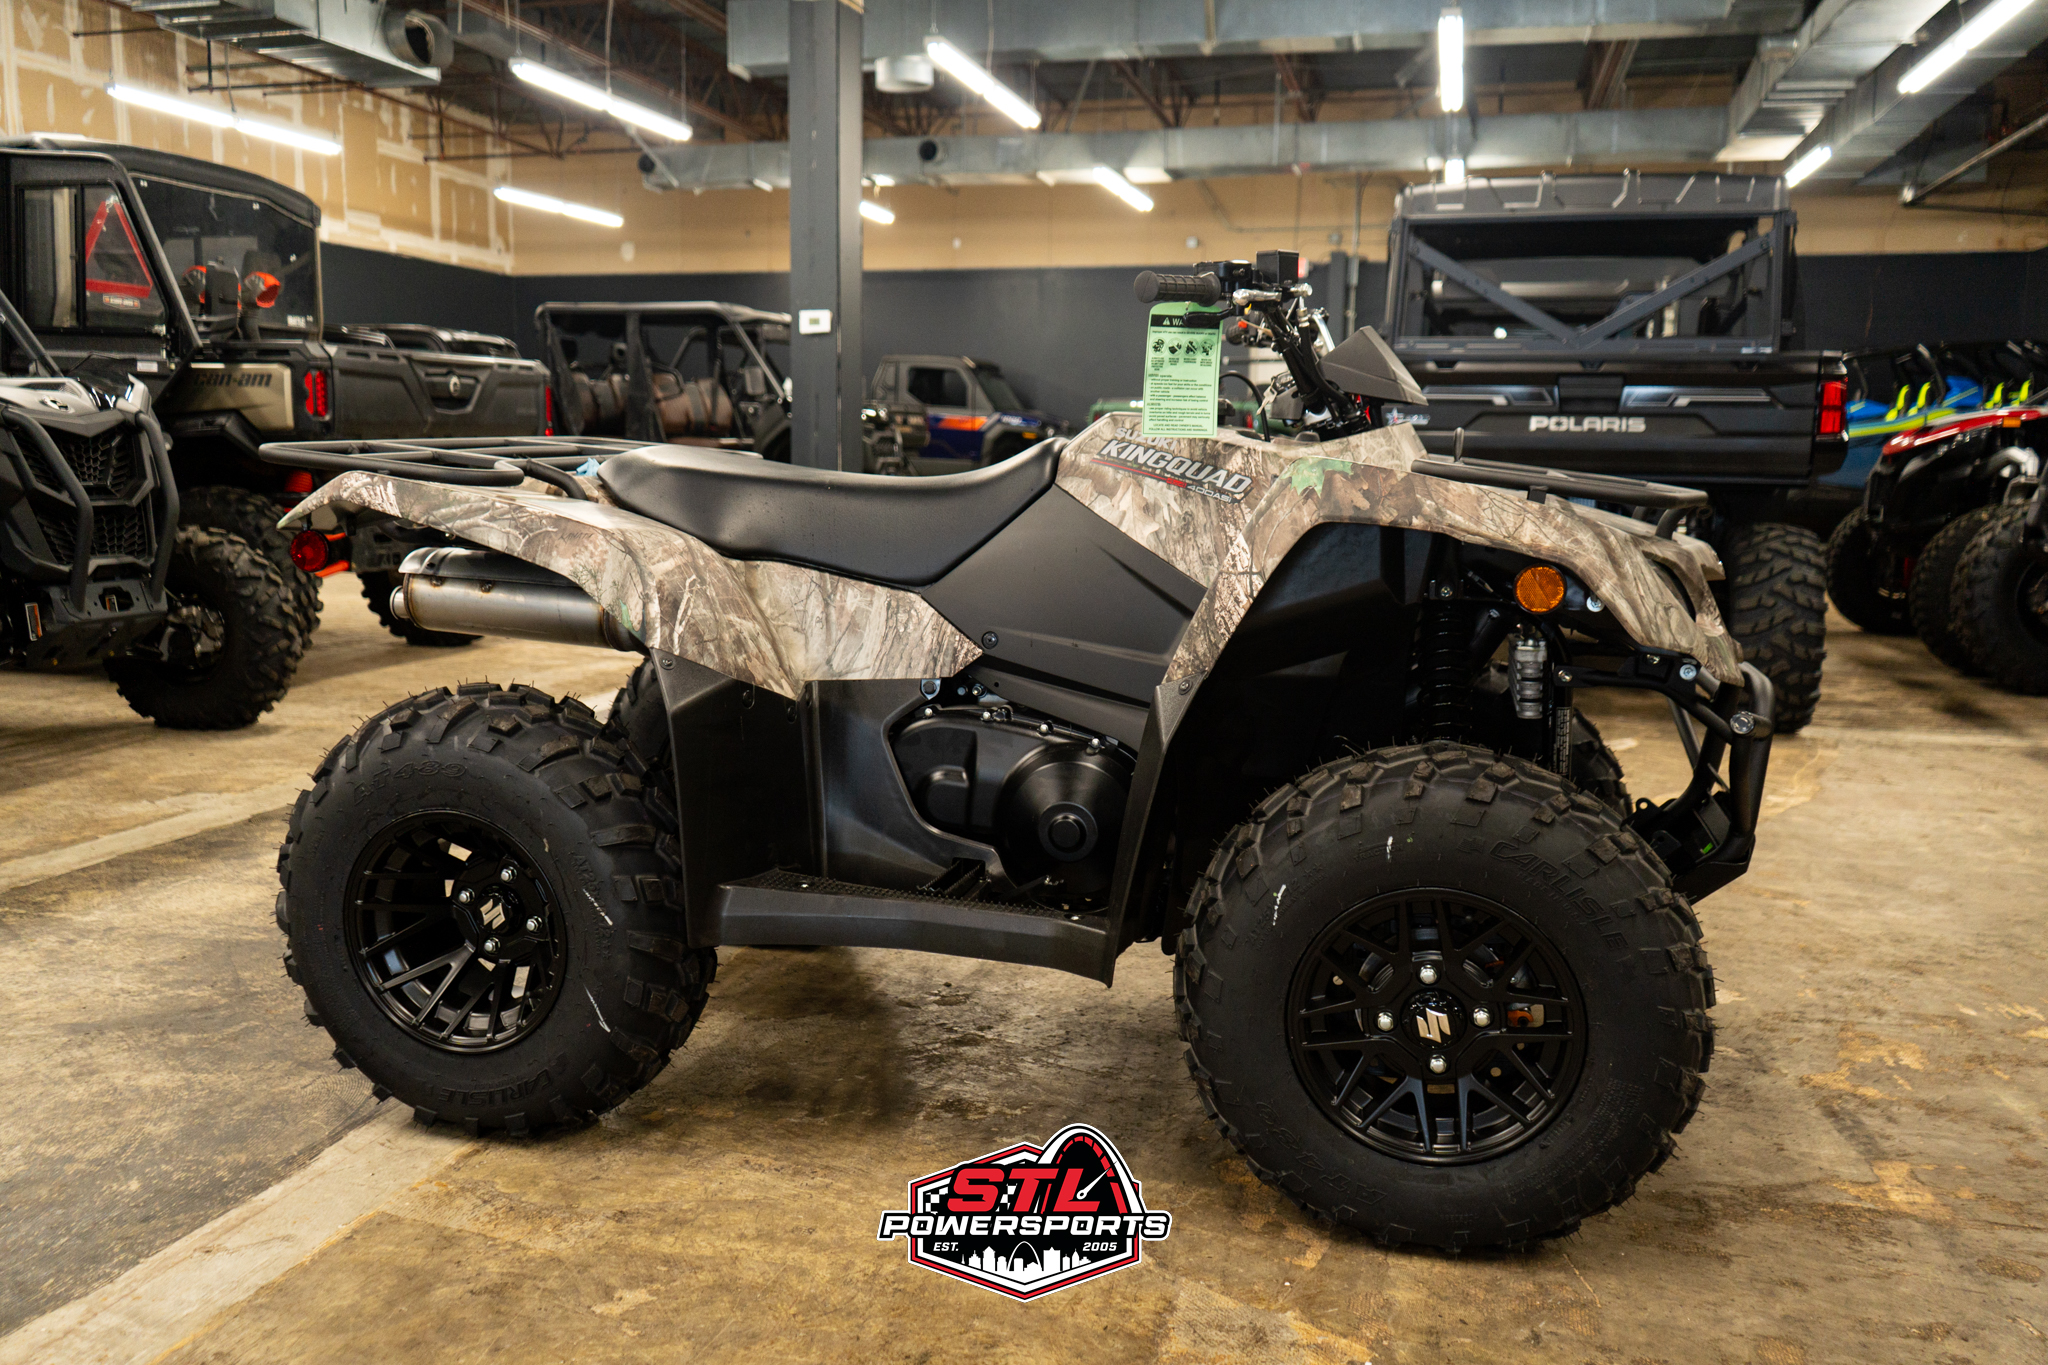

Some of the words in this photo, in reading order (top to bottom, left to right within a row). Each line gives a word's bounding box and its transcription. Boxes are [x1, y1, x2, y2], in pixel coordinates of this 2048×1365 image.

[1114, 427, 1178, 451] SUZUKI
[1529, 415, 1646, 433] POLARIS
[1100, 439, 1253, 494] KINGQUAD
[1490, 840, 1630, 948] CARLISLE
[438, 1068, 552, 1106] CARLISLE
